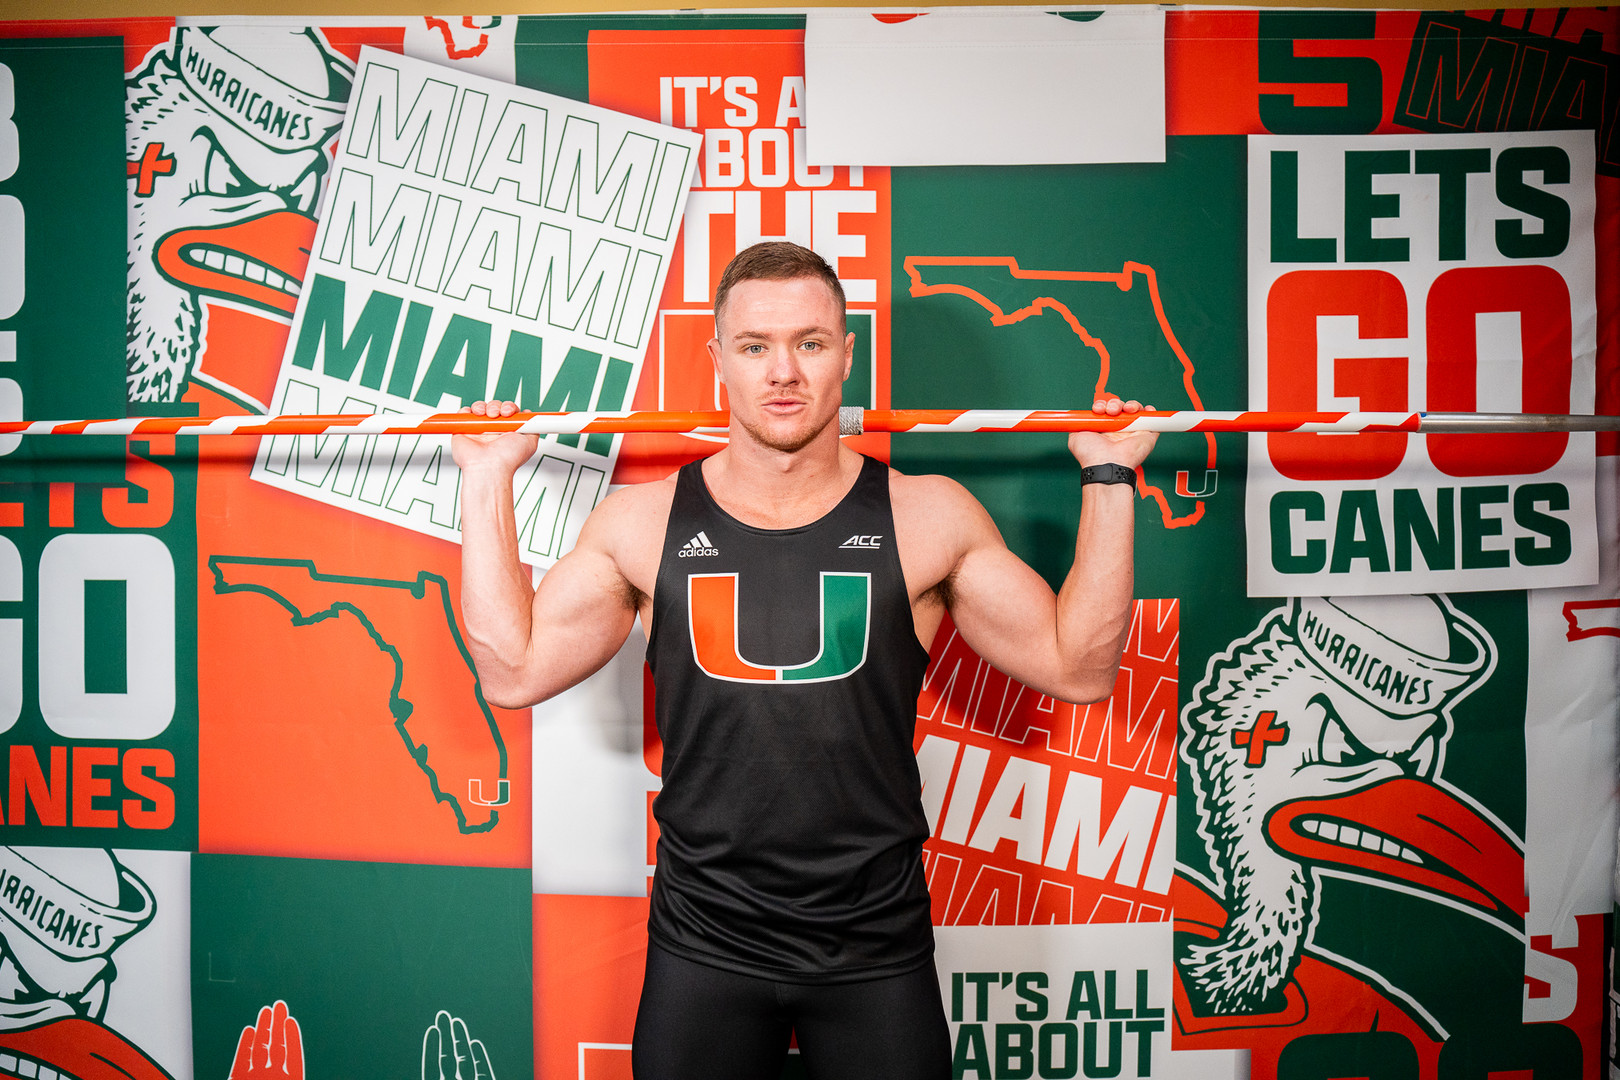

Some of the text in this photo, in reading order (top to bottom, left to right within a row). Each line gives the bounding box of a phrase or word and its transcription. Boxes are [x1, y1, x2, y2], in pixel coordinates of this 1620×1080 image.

[185, 50, 313, 141] HURRICANES
[659, 75, 759, 127] IT'S
[1405, 21, 1620, 166] MIA
[345, 61, 691, 242] MIAMI
[689, 128, 865, 188] BOU
[1270, 145, 1572, 264] LETS
[319, 167, 663, 349] MIAMI
[292, 272, 634, 458] MIAMI
[1266, 265, 1573, 481] GO
[678, 545, 719, 558] adidas
[841, 535, 883, 547] ACC
[1269, 482, 1572, 575] CANES
[0, 533, 176, 741] O
[687, 571, 872, 685] U
[1302, 609, 1434, 706] HURRICANES
[916, 629, 1179, 783] IAM
[0, 744, 176, 830] NES
[951, 968, 1166, 1023] IT'S ALL
[951, 1019, 1166, 1080] ABOUT
